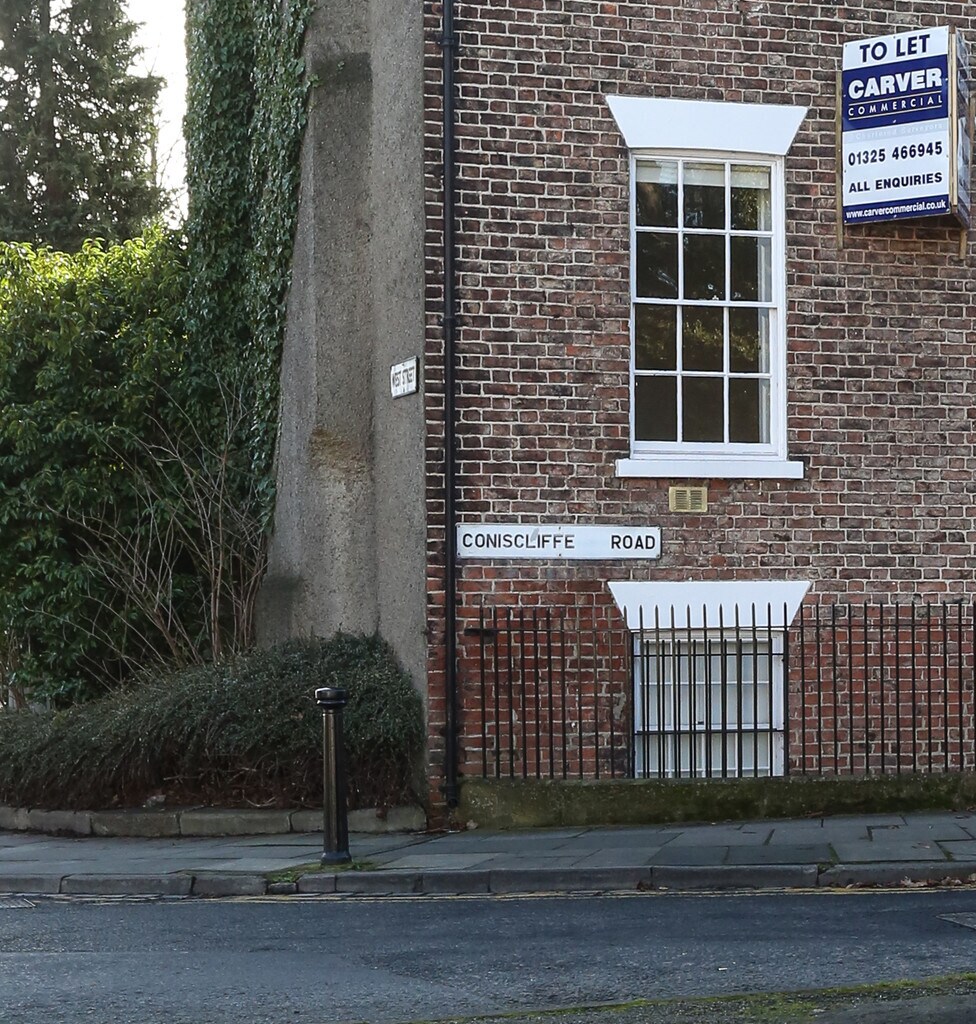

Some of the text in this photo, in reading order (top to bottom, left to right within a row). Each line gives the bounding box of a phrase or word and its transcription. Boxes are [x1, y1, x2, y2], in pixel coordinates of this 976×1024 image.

[860, 34, 930, 63] TO LET
[848, 68, 942, 99] CARVER
[848, 95, 943, 116] COMMERCIAL
[902, 122, 944, 135] Surveyors
[848, 141, 943, 166] 01325 466945
[849, 172, 943, 193] ALL ENQUIRIES
[845, 199, 947, 219] www.carvercommercial.co.uk
[462, 533, 656, 550] CONISCLIFFE ROAD
